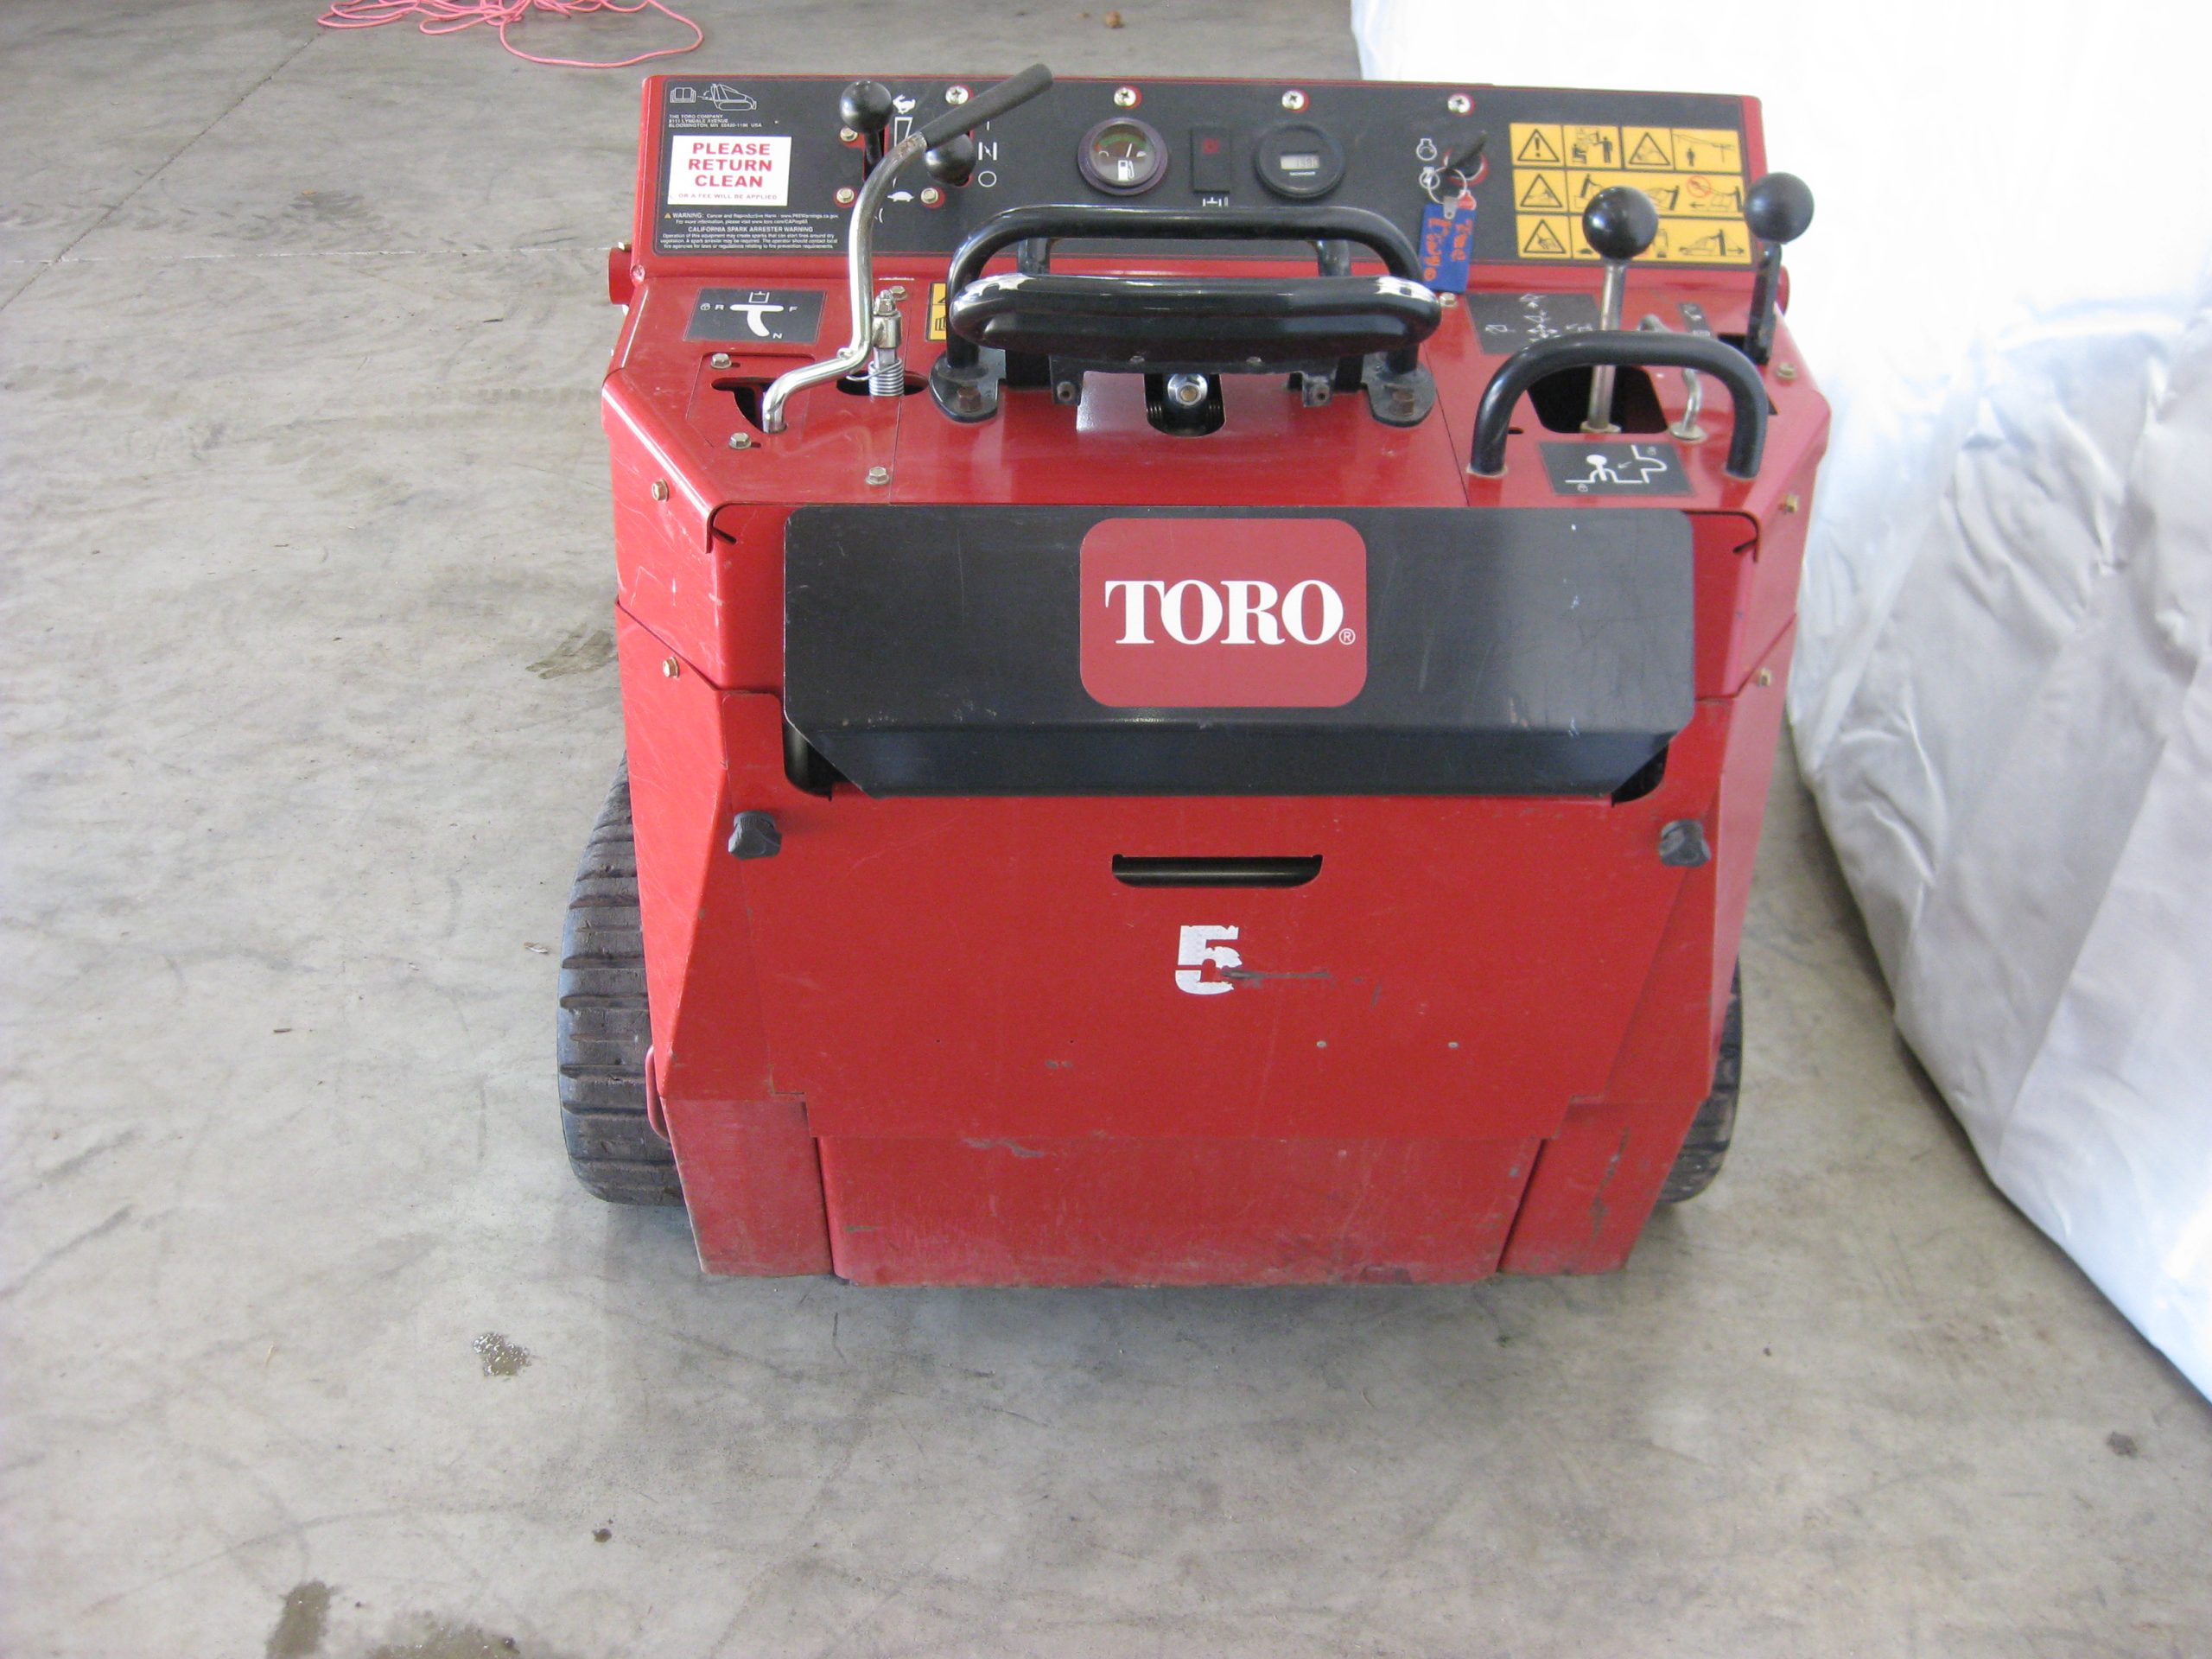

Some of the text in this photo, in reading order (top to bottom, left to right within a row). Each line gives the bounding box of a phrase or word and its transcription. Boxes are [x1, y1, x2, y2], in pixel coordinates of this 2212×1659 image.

[692, 143, 771, 156] PLEASE
[688, 158, 772, 172] RETURN
[695, 175, 764, 188] CLEAN
[1104, 579, 1344, 645] TORO
[1175, 925, 1243, 995] 5
